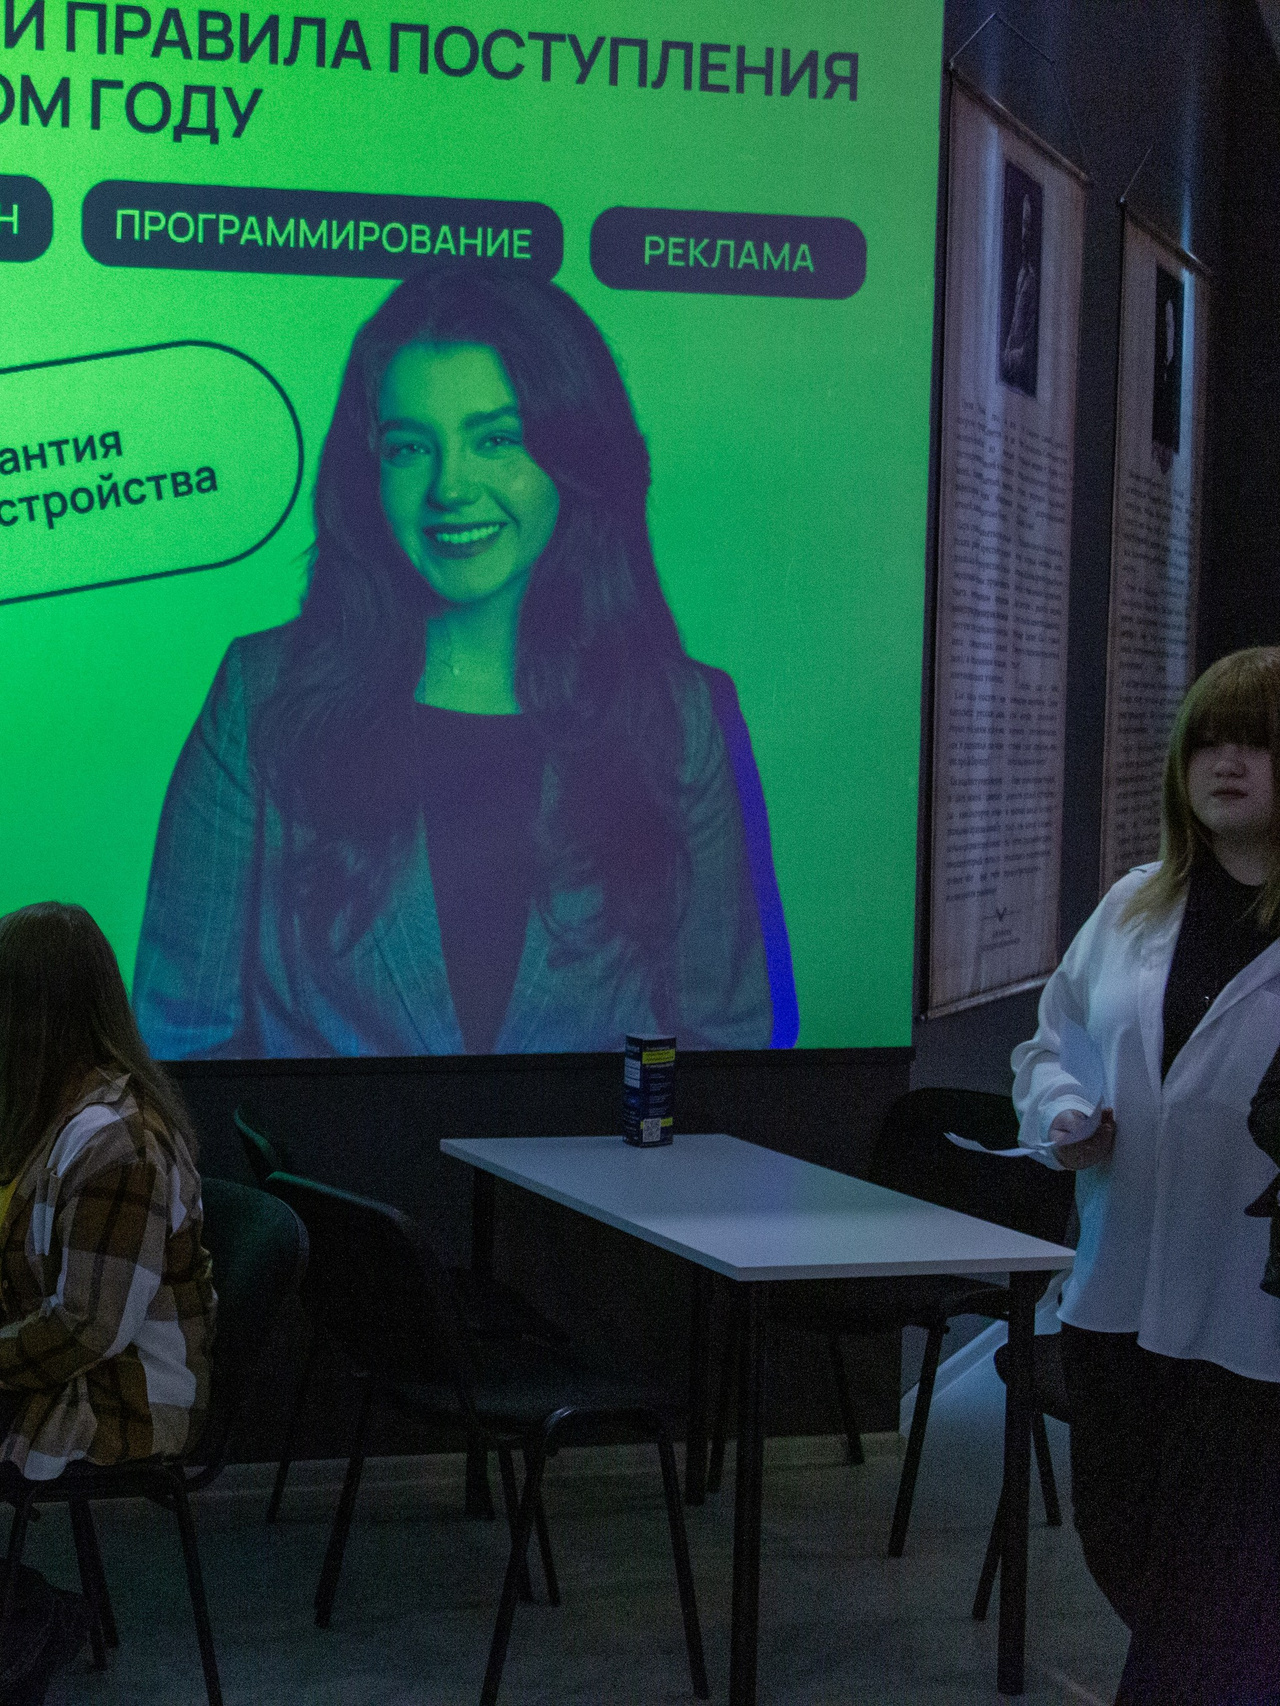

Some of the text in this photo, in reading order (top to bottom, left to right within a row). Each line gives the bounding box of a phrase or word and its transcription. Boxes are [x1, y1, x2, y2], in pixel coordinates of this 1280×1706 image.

[66, 1, 371, 71] ПРАВИЛА
[390, 22, 860, 101] ПОСТУПЛЕНИЯ
[91, 79, 263, 145] ГОДУ
[114, 208, 532, 260] ПРОГРАММИРОВАНИЕ
[643, 235, 815, 273] РЕКЛАМА
